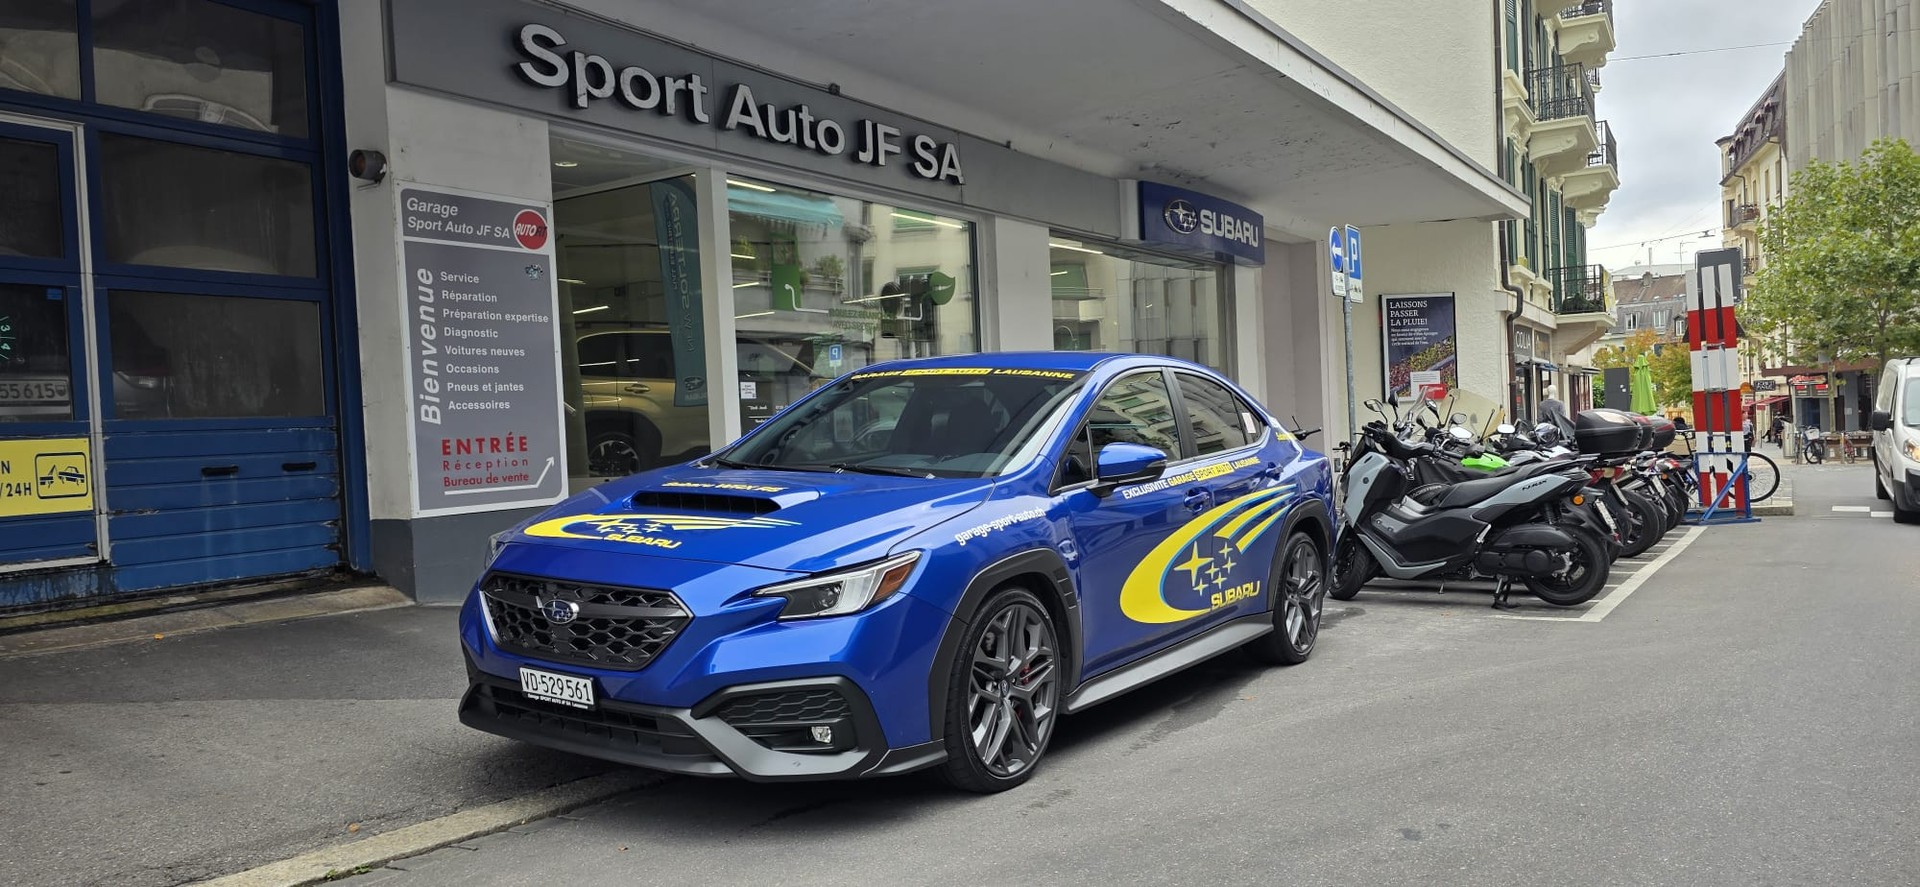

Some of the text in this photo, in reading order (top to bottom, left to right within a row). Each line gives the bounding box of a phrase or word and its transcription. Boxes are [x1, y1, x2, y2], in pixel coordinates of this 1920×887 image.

[518, 22, 966, 185] Sport Auto JF SA
[406, 198, 458, 218] Garage
[408, 216, 510, 238] Sport Auto JF SA
[1200, 209, 1258, 247] SUBARU
[1349, 237, 1358, 273] P
[440, 272, 480, 283] Service
[442, 290, 497, 302] Réparation
[443, 309, 549, 323] Préparation expertise
[444, 327, 498, 339] Diagnostic
[417, 268, 441, 425] Bienvenue
[445, 346, 525, 356] Voitures neuves
[446, 364, 500, 374] Occasions
[993, 369, 1075, 379] LAUSANNE
[24, 384, 55, 398] 615
[447, 382, 524, 393] Pneus et jantes
[448, 400, 510, 410] Accessoires
[442, 432, 528, 456] ENTRÉE
[443, 457, 528, 471] Réception
[444, 473, 529, 487] Bureau de vente
[1122, 480, 1169, 499] EXCLUSIVITE
[1167, 472, 1196, 486] GARAGE
[1195, 468, 1215, 479] SPORT
[1215, 463, 1232, 473] AUTO
[955, 506, 1046, 546] garage-sport-auto.ch
[604, 534, 682, 548] SUBARU
[1211, 580, 1260, 610] SUBARU
